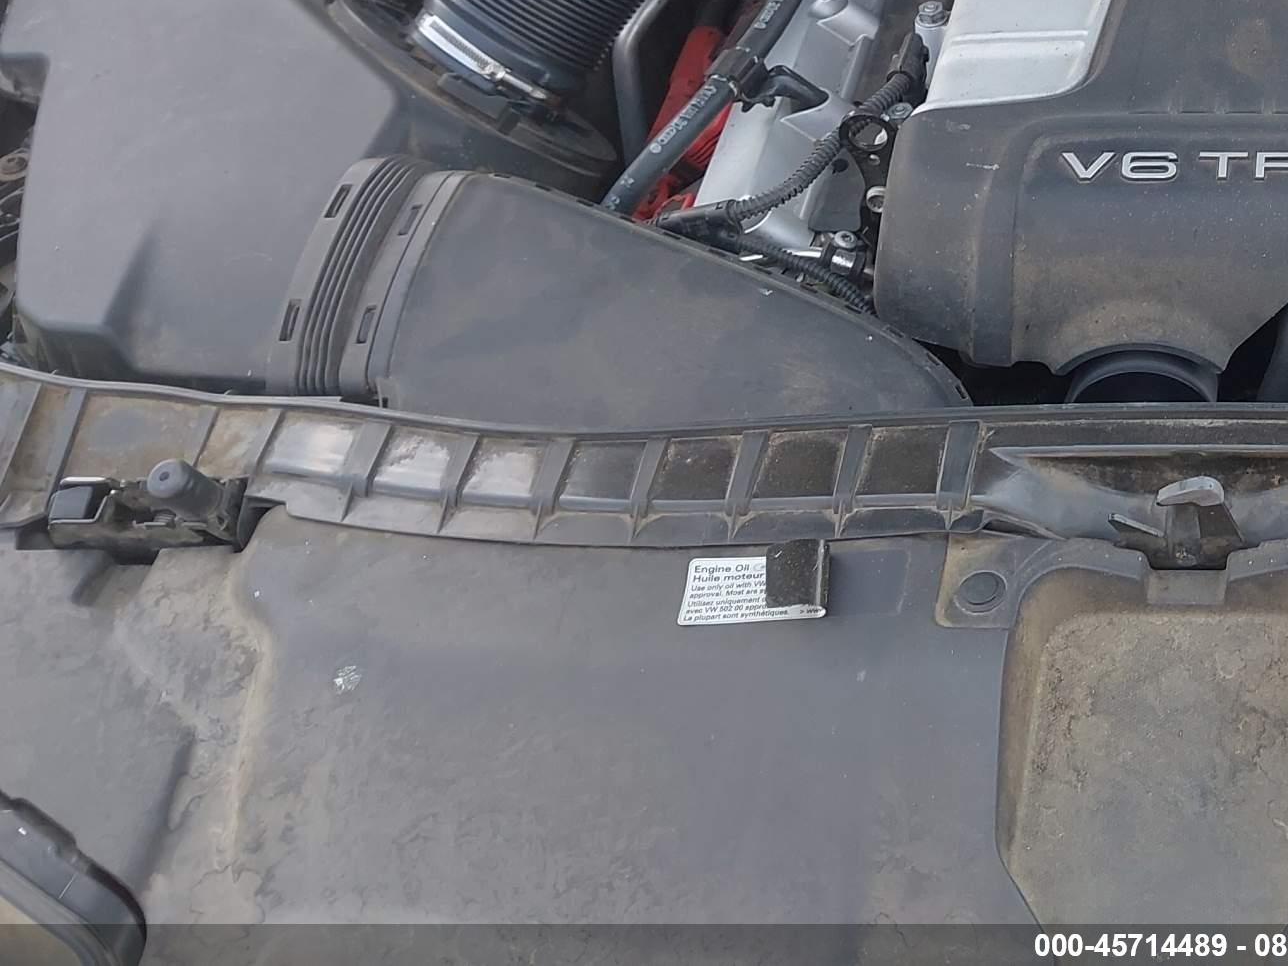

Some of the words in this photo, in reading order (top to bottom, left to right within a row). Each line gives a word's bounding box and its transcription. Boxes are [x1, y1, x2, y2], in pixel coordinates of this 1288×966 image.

[1062, 151, 1180, 182] V6
[694, 565, 732, 575] Engine
[735, 564, 750, 572] Oil
[693, 574, 721, 583] Huile
[724, 573, 765, 582] moteur
[707, 584, 724, 592] only
